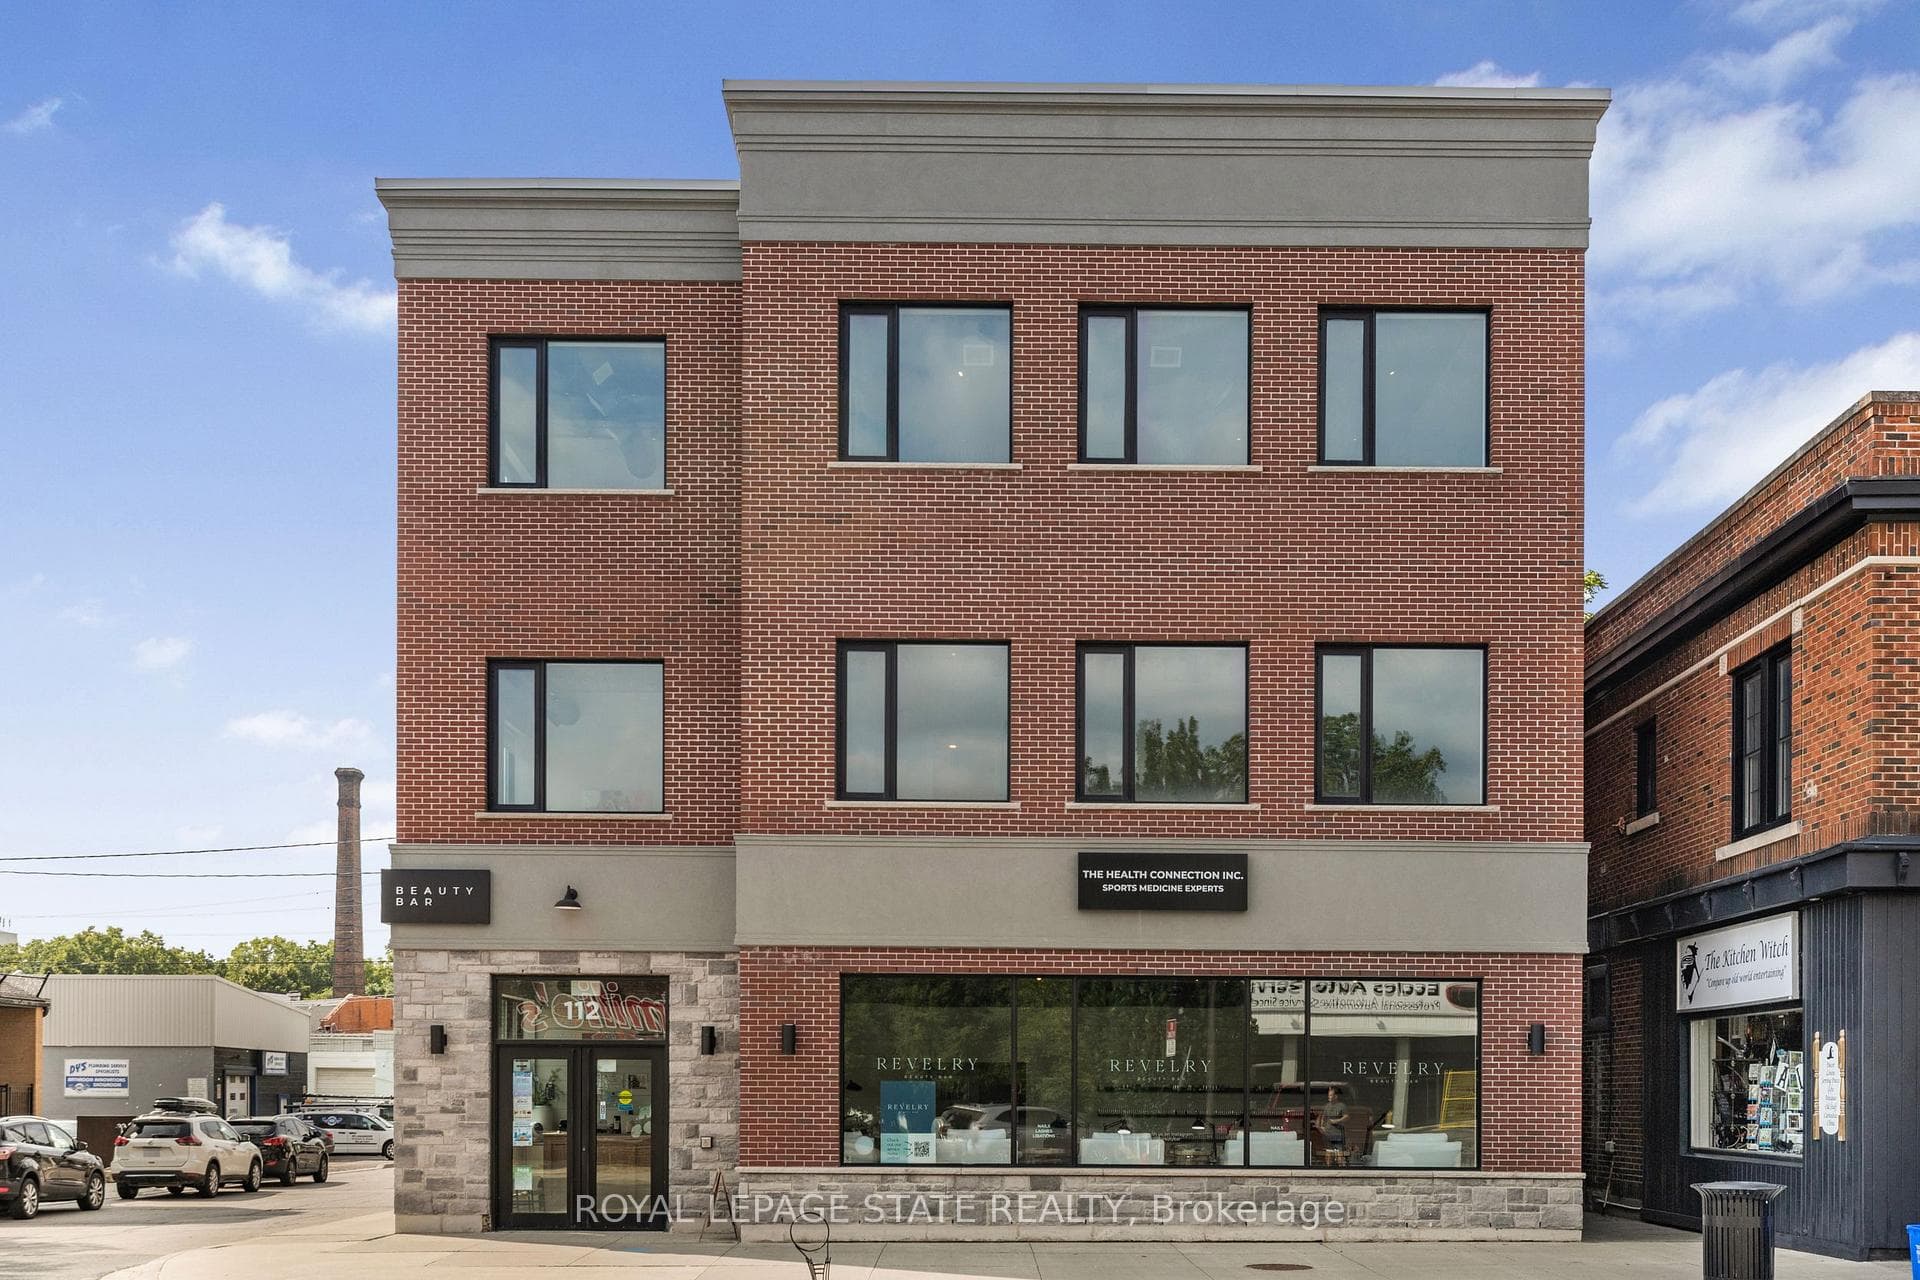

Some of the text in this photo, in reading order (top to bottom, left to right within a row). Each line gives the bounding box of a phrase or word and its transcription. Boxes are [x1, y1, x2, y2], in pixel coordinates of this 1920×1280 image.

[1082, 870, 1244, 880] THE HEALTH CONNECTION INC.
[395, 886, 474, 895] BEAUTY
[1102, 884, 1225, 893] SPORTS MEDICINE EXPERTS
[395, 898, 433, 906] BAR
[1704, 934, 1789, 971] The Kitchen Witch
[562, 1001, 601, 1021] 112
[877, 1057, 978, 1071] REVELRY
[1110, 1059, 1211, 1073] REVELRY
[1343, 1061, 1444, 1075] REVELRY
[887, 1103, 929, 1111] REVELRY
